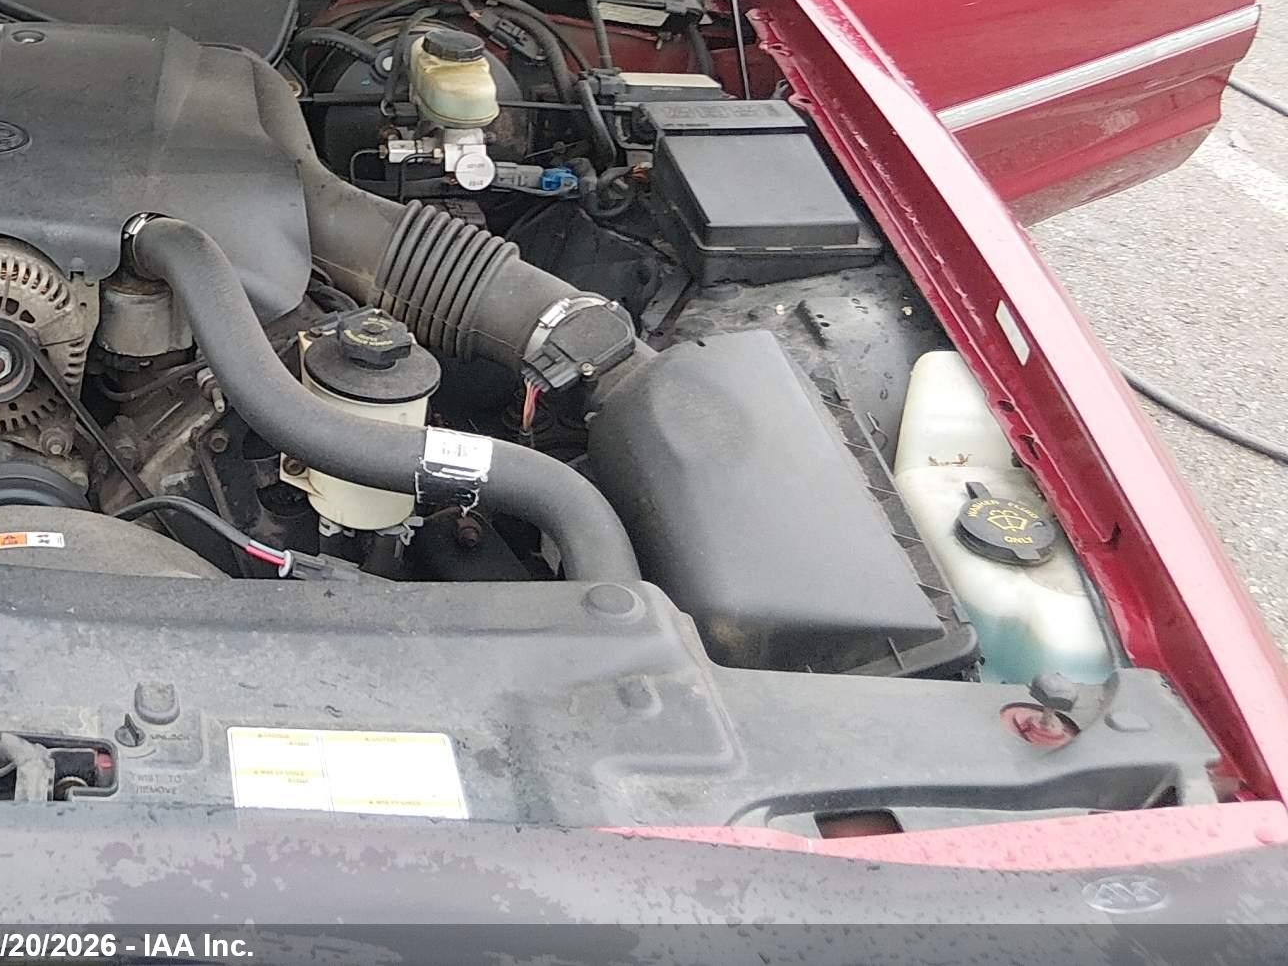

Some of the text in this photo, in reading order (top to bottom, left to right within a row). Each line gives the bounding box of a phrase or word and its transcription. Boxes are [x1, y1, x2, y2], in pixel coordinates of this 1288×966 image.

[967, 499, 1040, 520] WASHER FLUID
[1003, 536, 1034, 544] ONLY
[168, 774, 183, 784] TO
[136, 785, 178, 795] REMOVE
